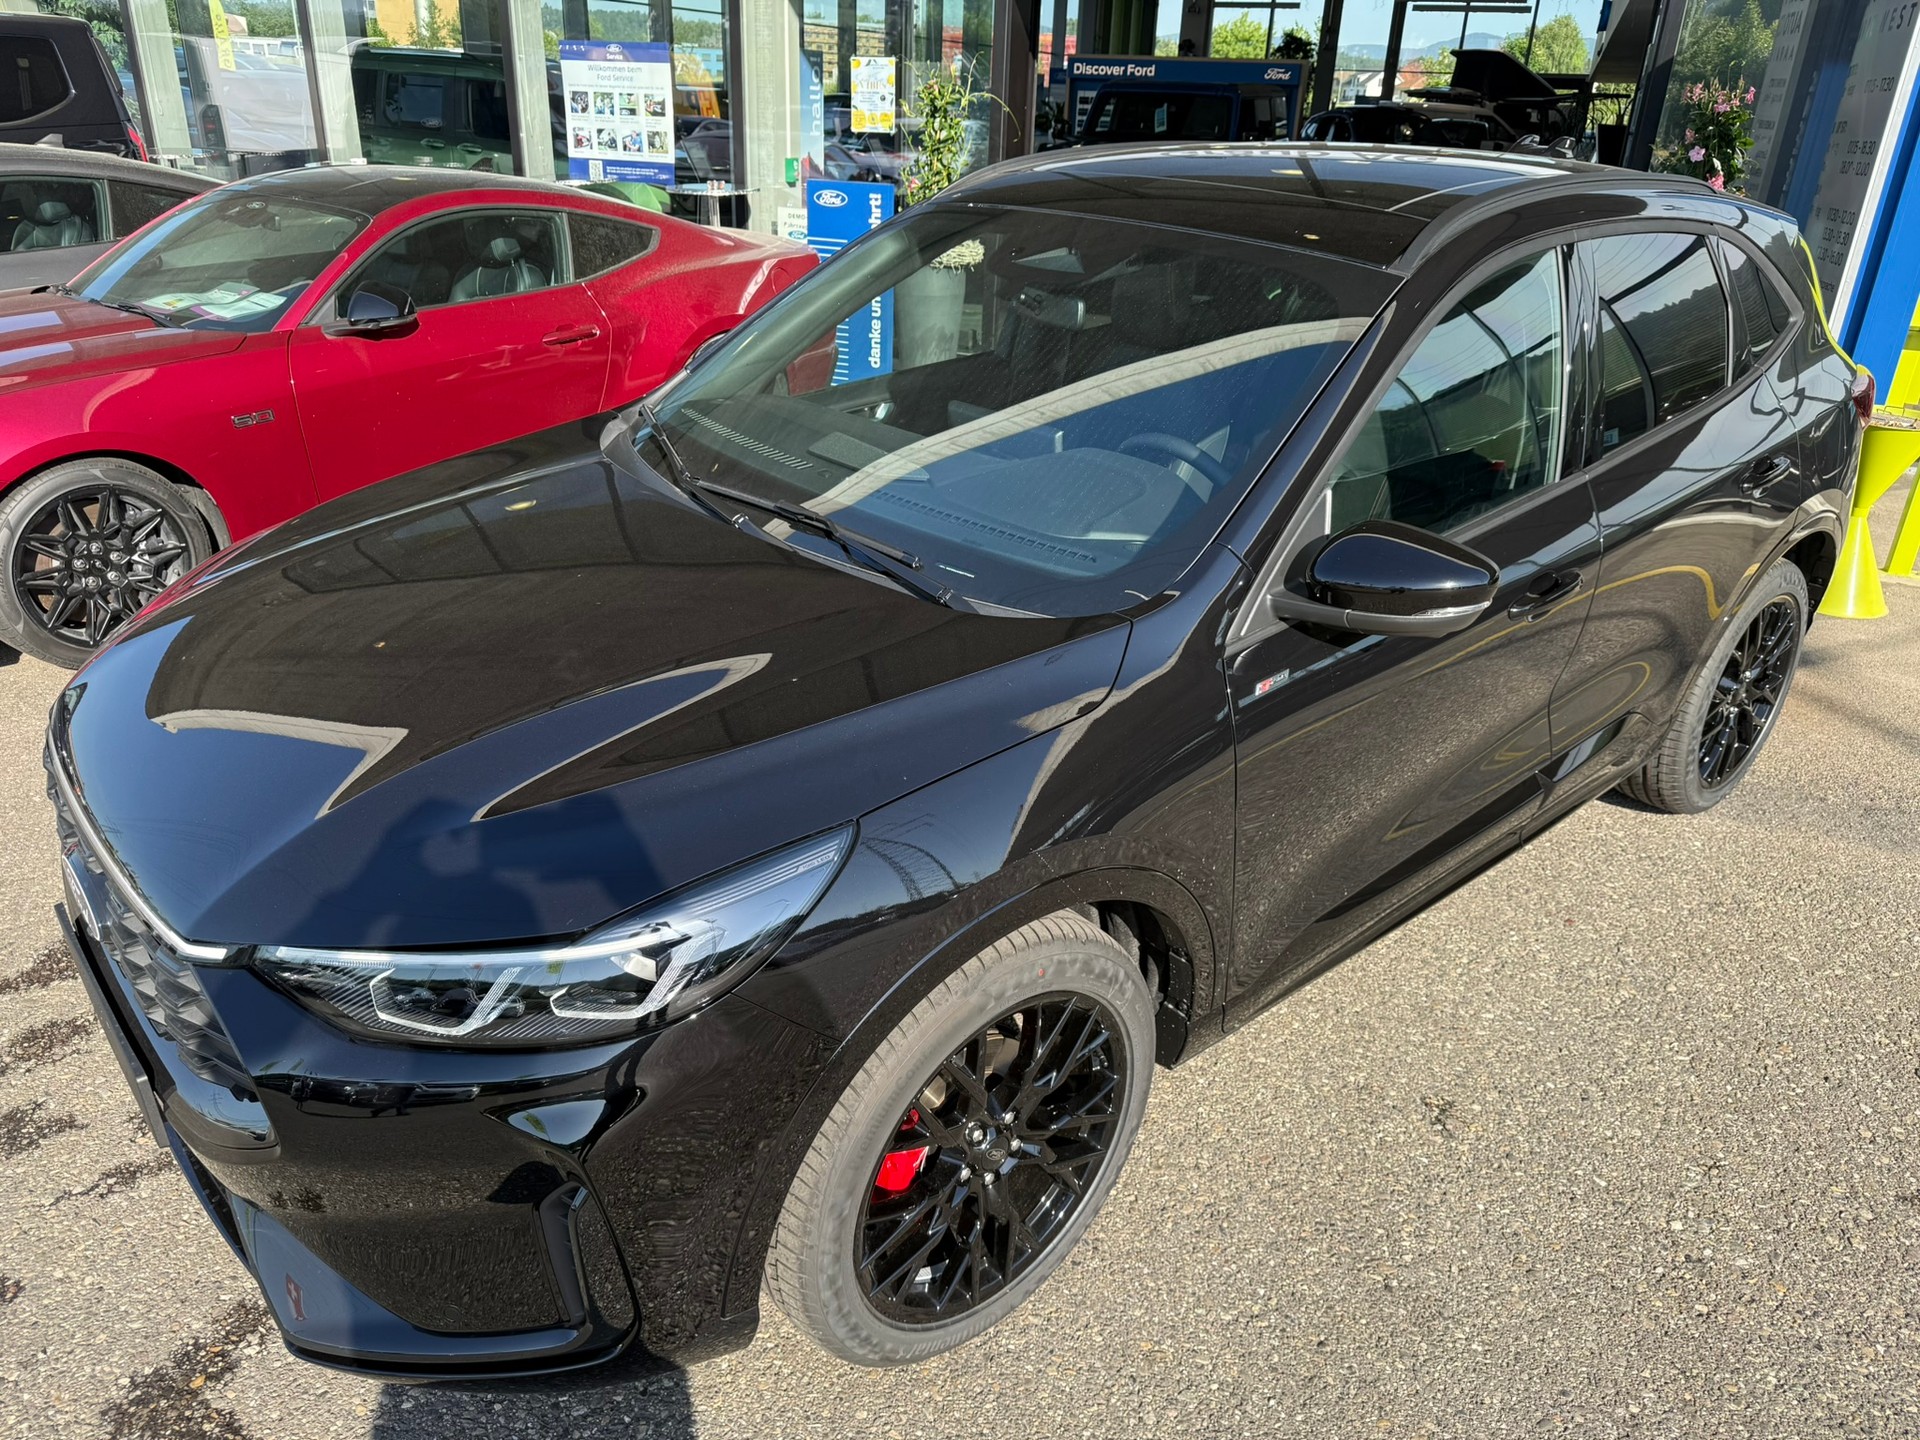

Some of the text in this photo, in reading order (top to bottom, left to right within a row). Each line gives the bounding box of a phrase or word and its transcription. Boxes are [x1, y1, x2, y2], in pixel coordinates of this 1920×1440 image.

[588, 64, 642, 73] Willkommen beim
[1073, 62, 1126, 76] Discover
[1127, 63, 1155, 77] Ford
[1264, 67, 1291, 81] Ford
[613, 74, 634, 82] Service
[817, 191, 845, 206] Ford
[868, 295, 882, 368] danke un
